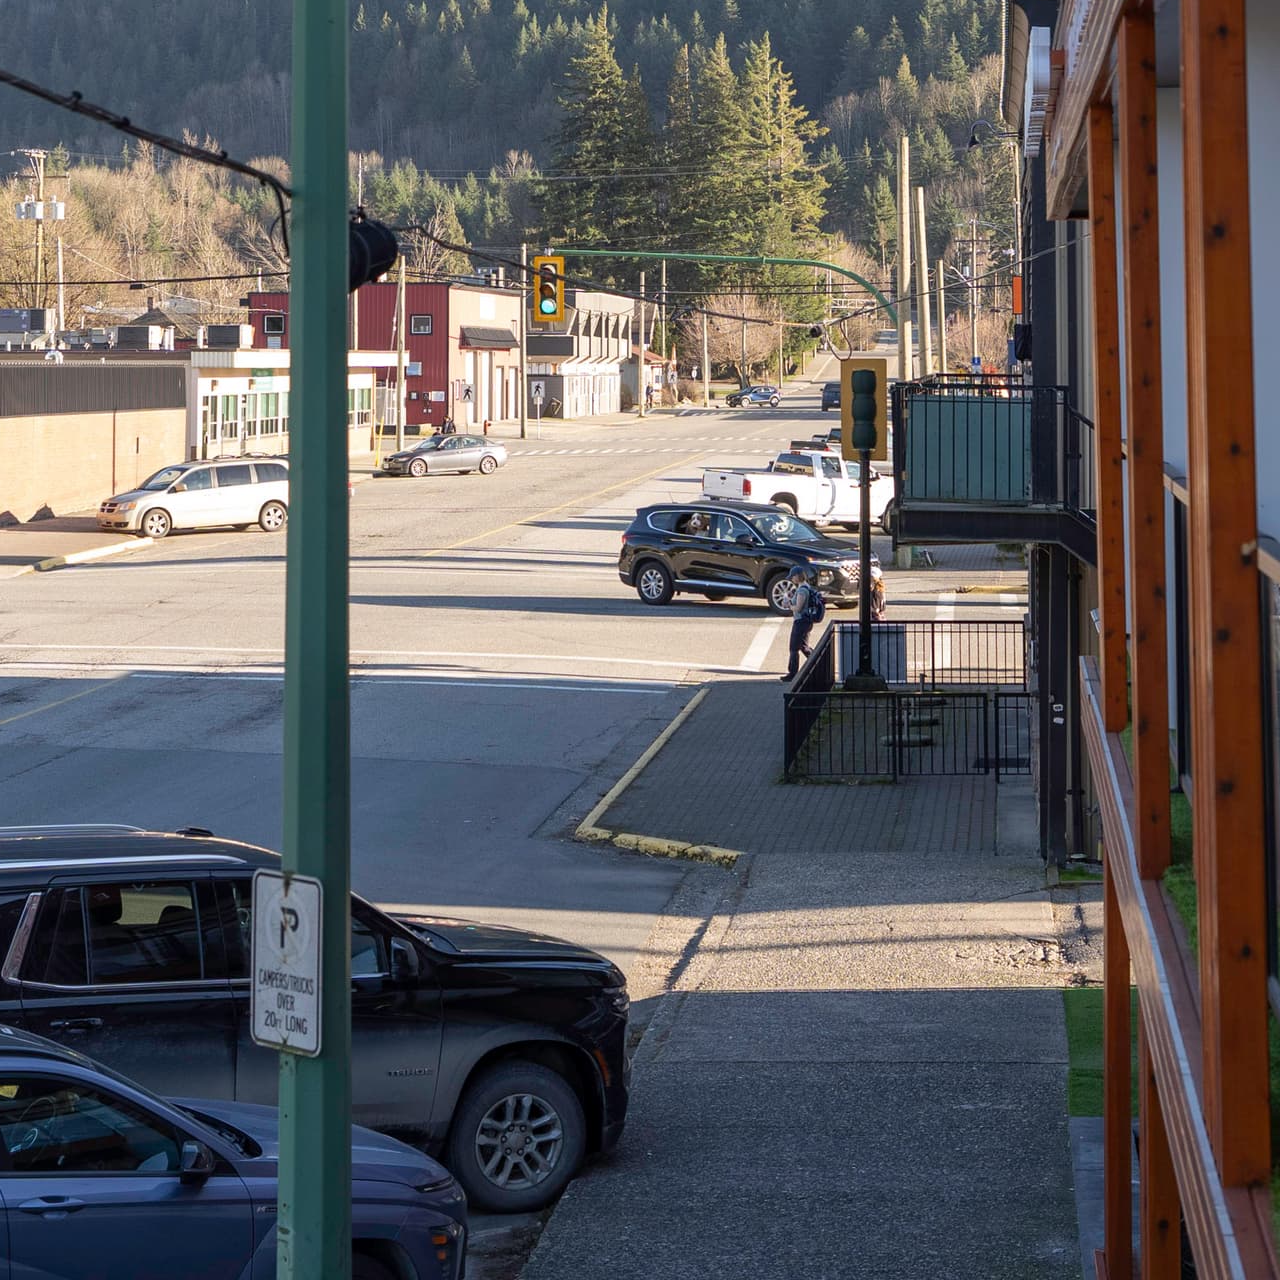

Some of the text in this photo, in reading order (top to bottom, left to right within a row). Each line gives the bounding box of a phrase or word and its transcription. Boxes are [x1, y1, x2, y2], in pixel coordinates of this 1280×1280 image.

[259, 968, 314, 996] CAMPERS/TRUCKS
[277, 992, 295, 1011] OVER
[285, 1015, 307, 1035] LONG
